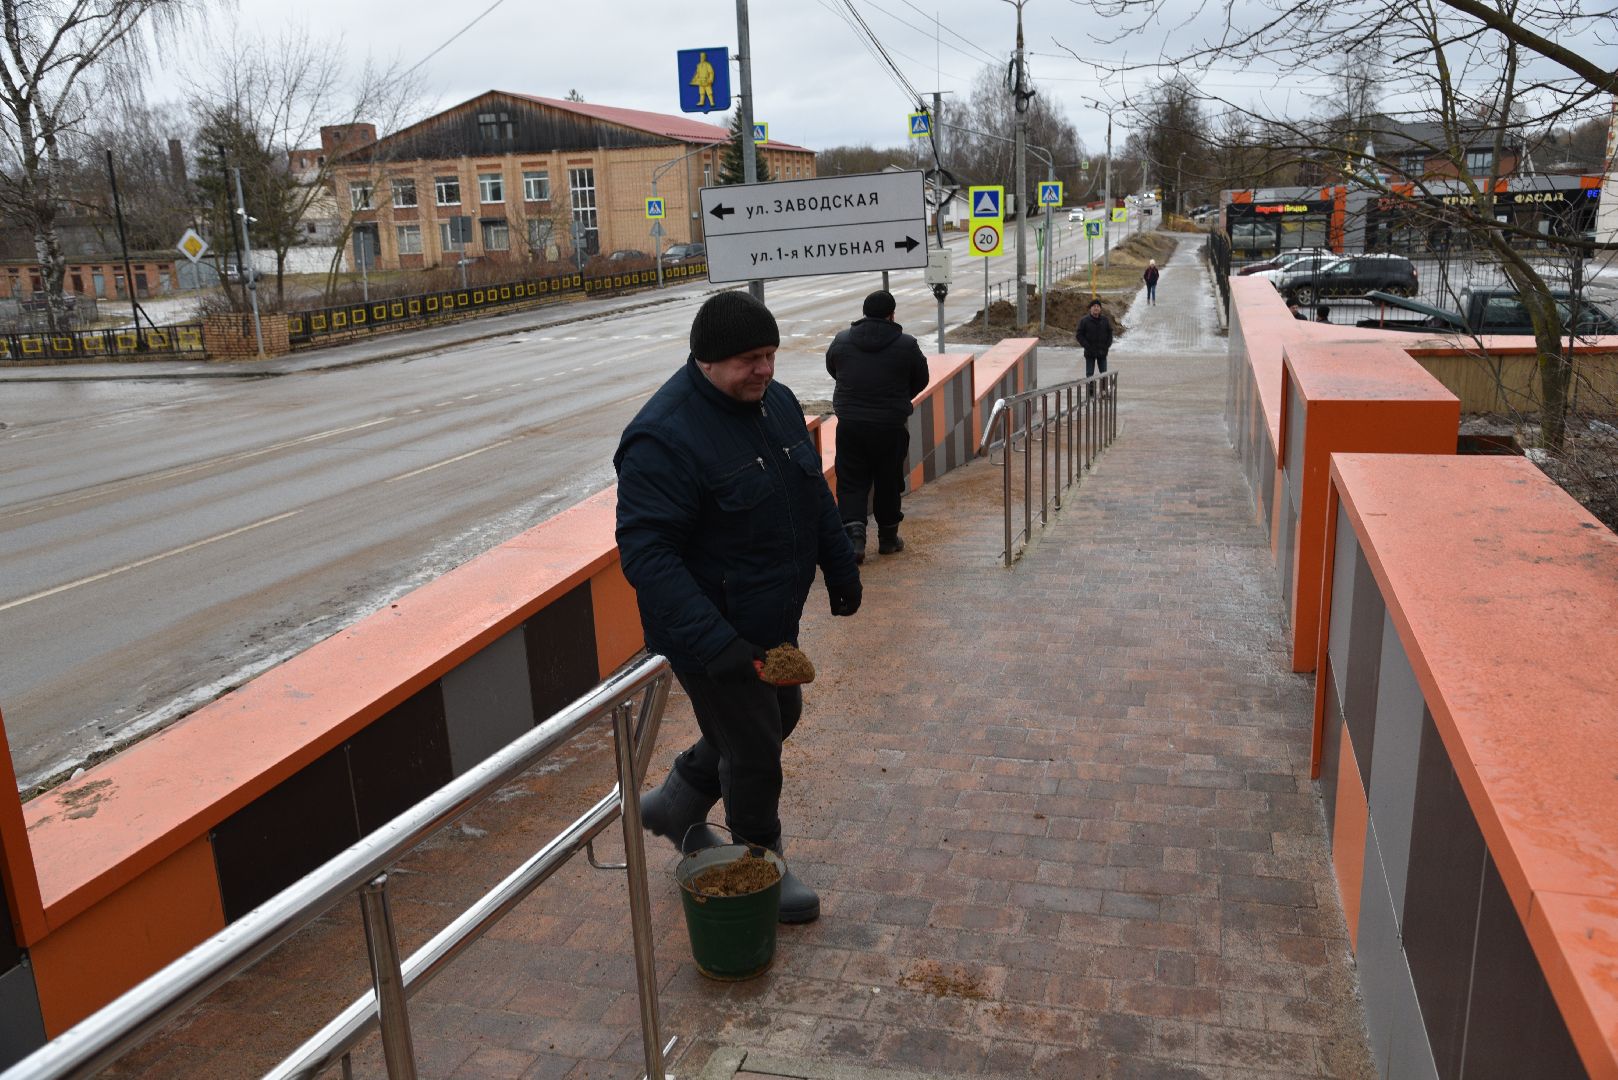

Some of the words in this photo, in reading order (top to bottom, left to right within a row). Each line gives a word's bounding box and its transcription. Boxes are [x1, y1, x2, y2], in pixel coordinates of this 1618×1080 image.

[746, 205, 769, 219] ул.
[774, 192, 879, 213] ЗАВОДСКАЯ
[979, 233, 993, 245] 20
[751, 252, 773, 265] ул.
[777, 247, 798, 260] 1-я
[804, 240, 885, 258] КЛУБНАЯ
